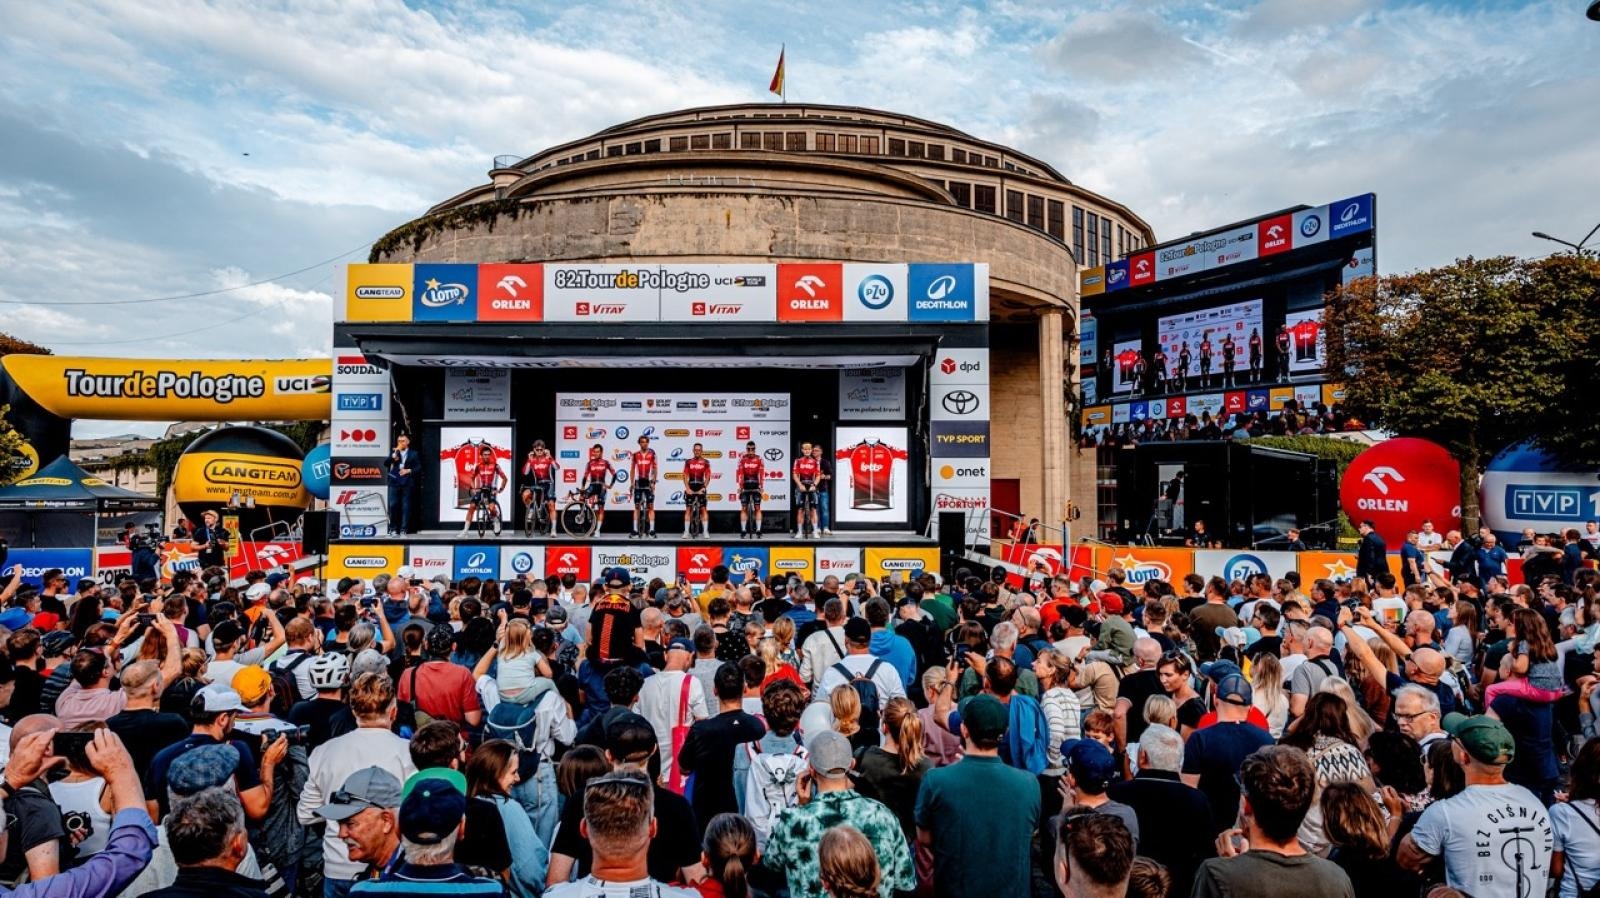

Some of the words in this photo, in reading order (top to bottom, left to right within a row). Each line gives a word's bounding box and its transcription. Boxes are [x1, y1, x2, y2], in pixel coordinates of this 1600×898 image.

[1264, 238, 1286, 249] ORLEN
[714, 278, 733, 286] UCI
[430, 288, 460, 302] LOTTO
[491, 299, 531, 310] ORLEN
[790, 299, 829, 310] ORLEN
[916, 300, 968, 310] DECATHLON
[337, 365, 382, 375] SOUDAL
[959, 361, 980, 373] dpd
[278, 378, 309, 391] UCI
[343, 398, 368, 408] TVP
[370, 396, 377, 409] 1
[936, 435, 955, 443] TVP
[956, 435, 986, 443] SPORT
[212, 466, 297, 482] LANGTEAM
[351, 467, 381, 475] GRUPA
[956, 466, 985, 477] onet
[1357, 498, 1409, 512] ORLEN
[1517, 494, 1574, 512] TVP
[1589, 491, 1600, 517] 1
[20, 567, 85, 576] DECALON
[1127, 568, 1159, 583] LOTTO
[1476, 829, 1491, 857] BEZ
[1487, 803, 1554, 853] CIŚNIENIA
